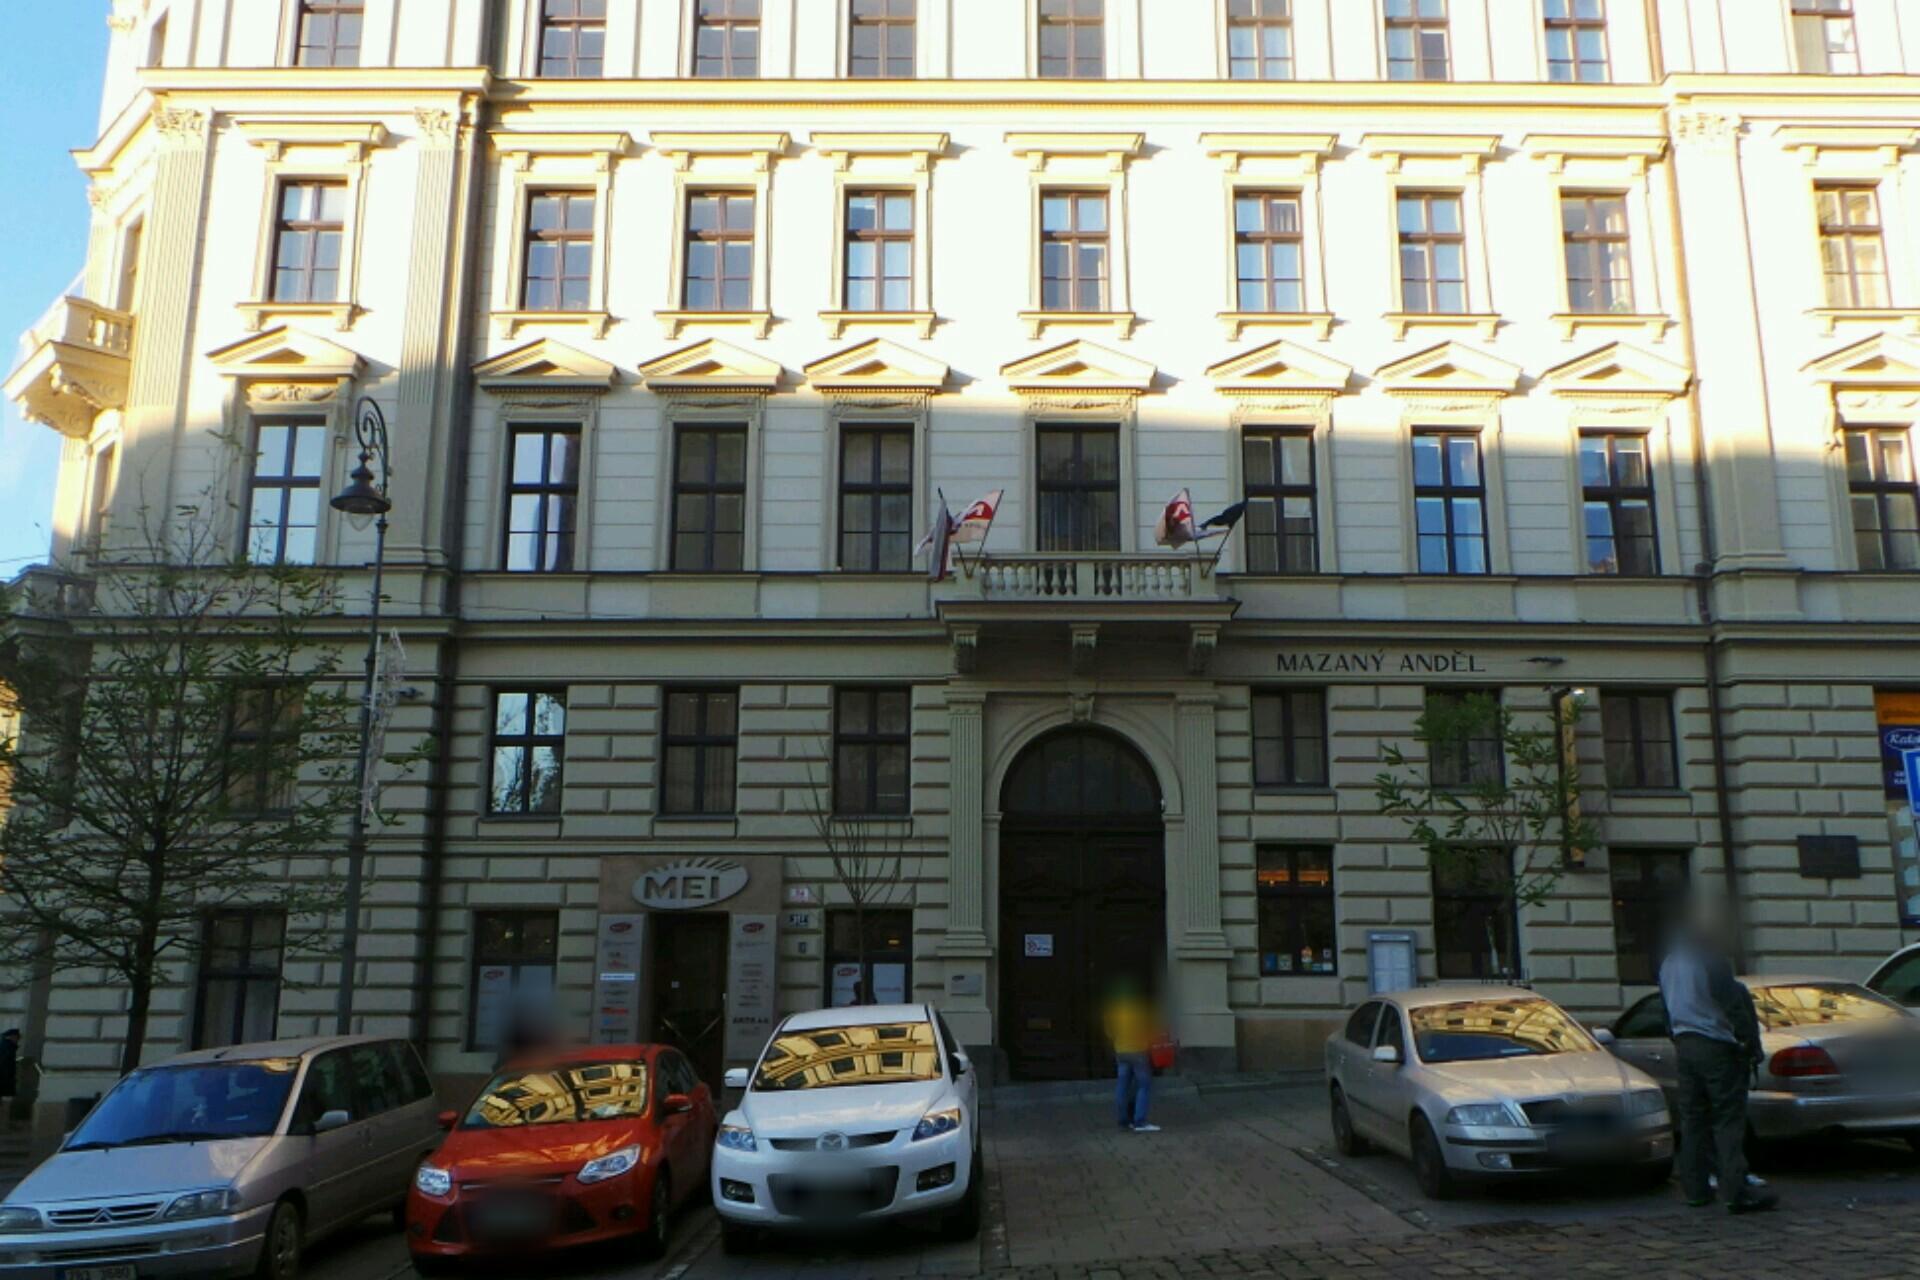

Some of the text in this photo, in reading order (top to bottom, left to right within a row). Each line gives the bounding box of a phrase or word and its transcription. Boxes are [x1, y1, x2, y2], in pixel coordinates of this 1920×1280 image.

[1277, 649, 1486, 673] MAZANÝ ANDĚL
[643, 876, 720, 899] MEI
